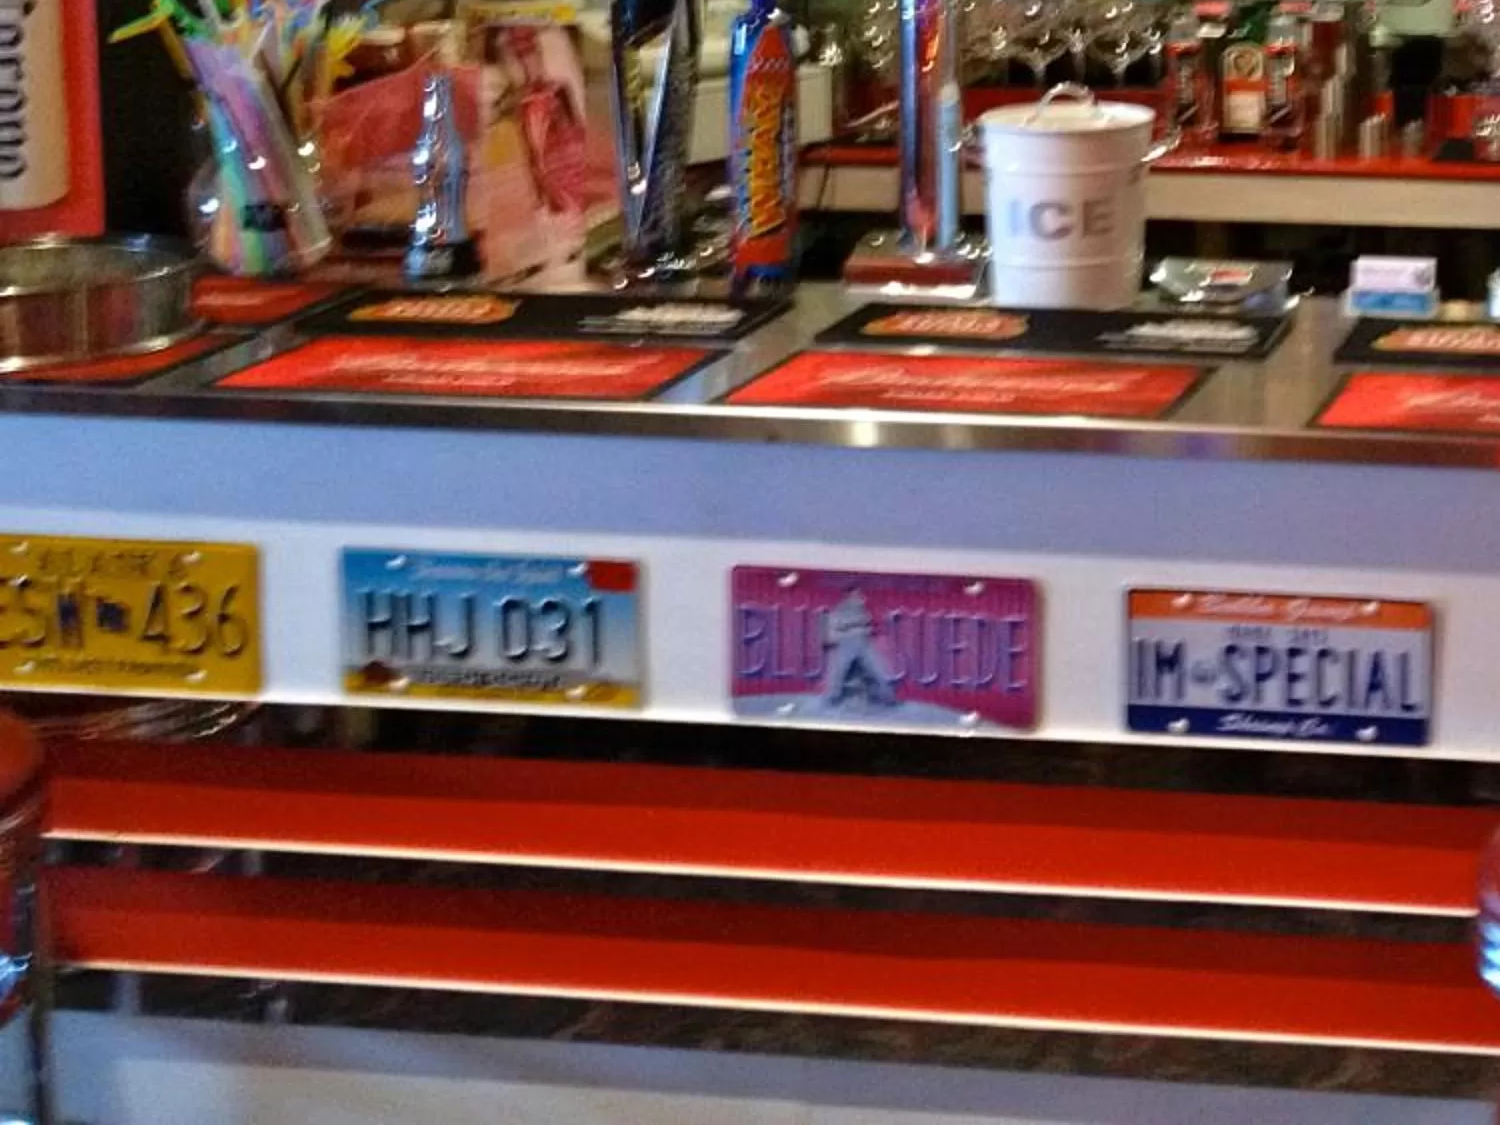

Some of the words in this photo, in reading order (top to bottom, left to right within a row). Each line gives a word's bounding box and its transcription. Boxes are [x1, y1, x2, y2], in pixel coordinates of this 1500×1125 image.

[1005, 198, 1117, 242] ICE
[139, 580, 248, 658] 436
[358, 588, 475, 663] HHJ
[495, 593, 601, 666] 031
[738, 603, 842, 679] BLU
[1219, 642, 1424, 713] SPECIAL
